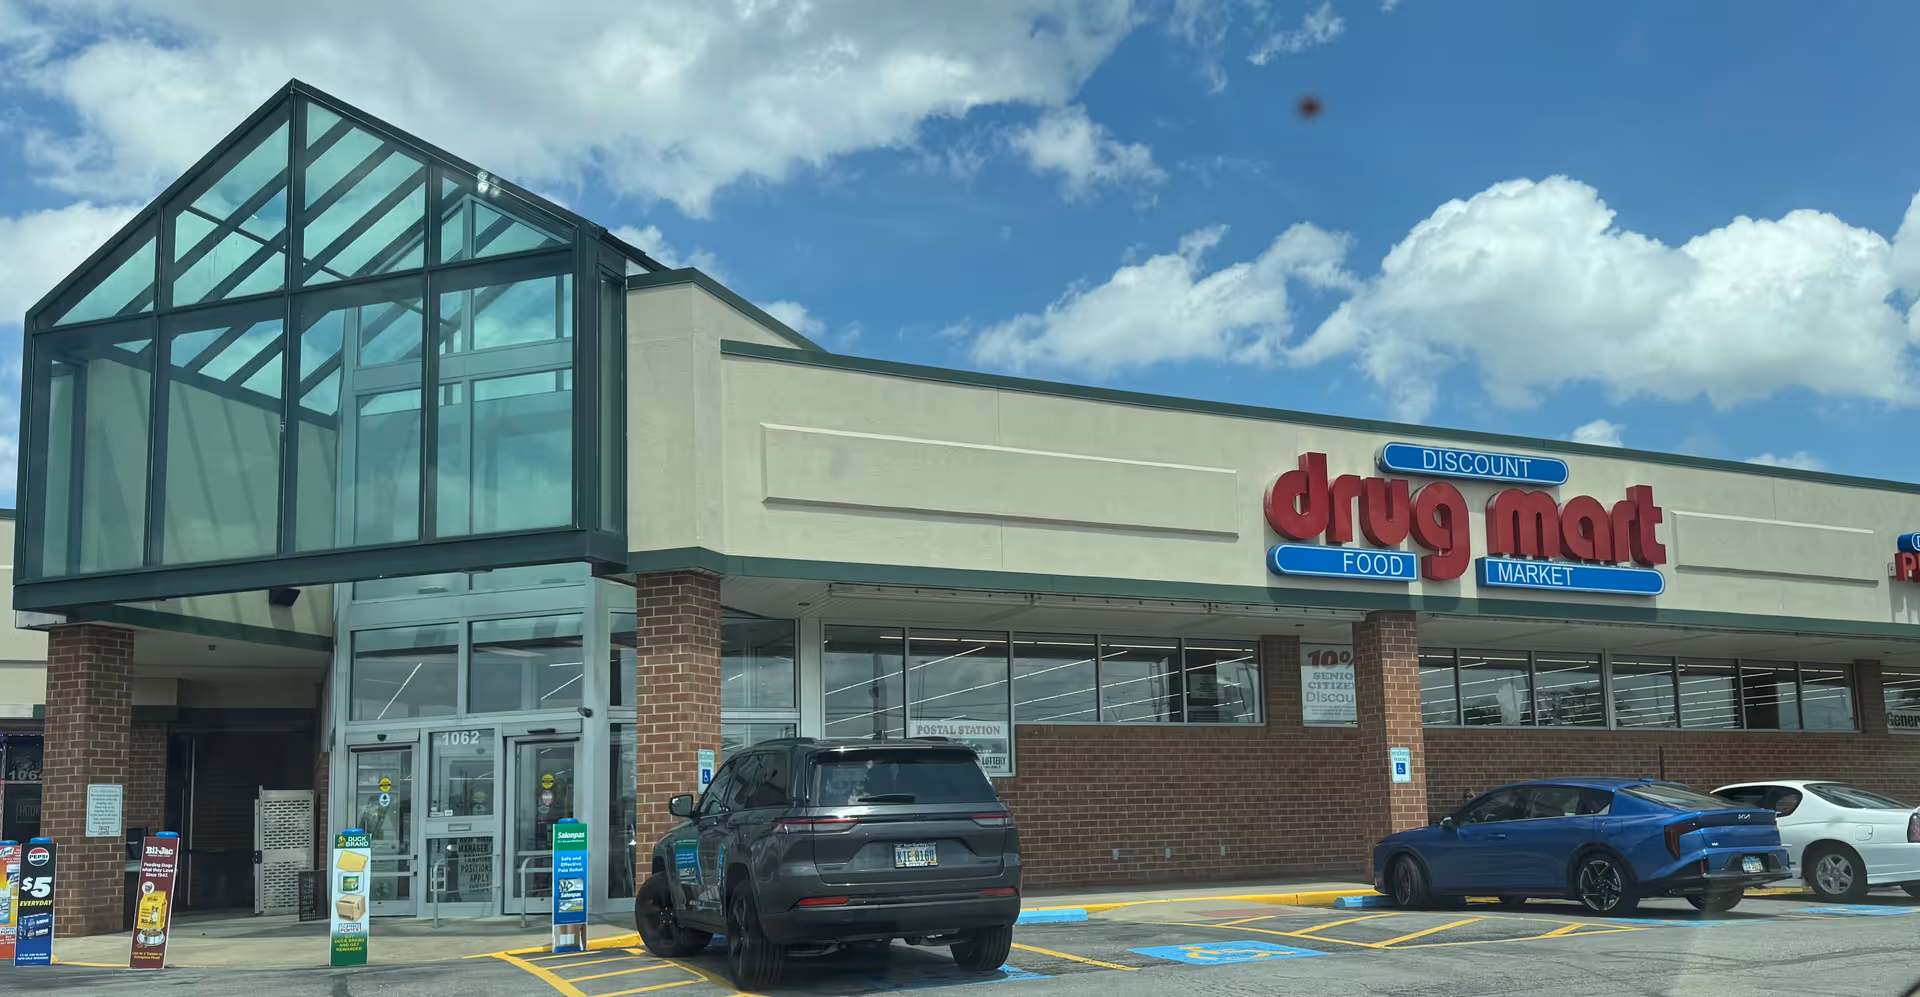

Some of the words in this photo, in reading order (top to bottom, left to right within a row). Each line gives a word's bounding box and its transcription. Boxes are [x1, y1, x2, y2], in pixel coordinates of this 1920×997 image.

[1422, 449, 1532, 479] DISCOUNT
[1264, 452, 1470, 581] drug
[1486, 484, 1667, 565] mart
[1342, 552, 1404, 575] FOOD
[1498, 562, 1575, 587] MARKET
[442, 730, 481, 746] 1062
[916, 725, 956, 735] POSTAL
[958, 726, 1000, 735] STATION
[982, 756, 1006, 766] LOTTERY
[460, 864, 492, 873] POSITIONS
[469, 874, 489, 882] APPLY
[21, 876, 52, 898] $5
